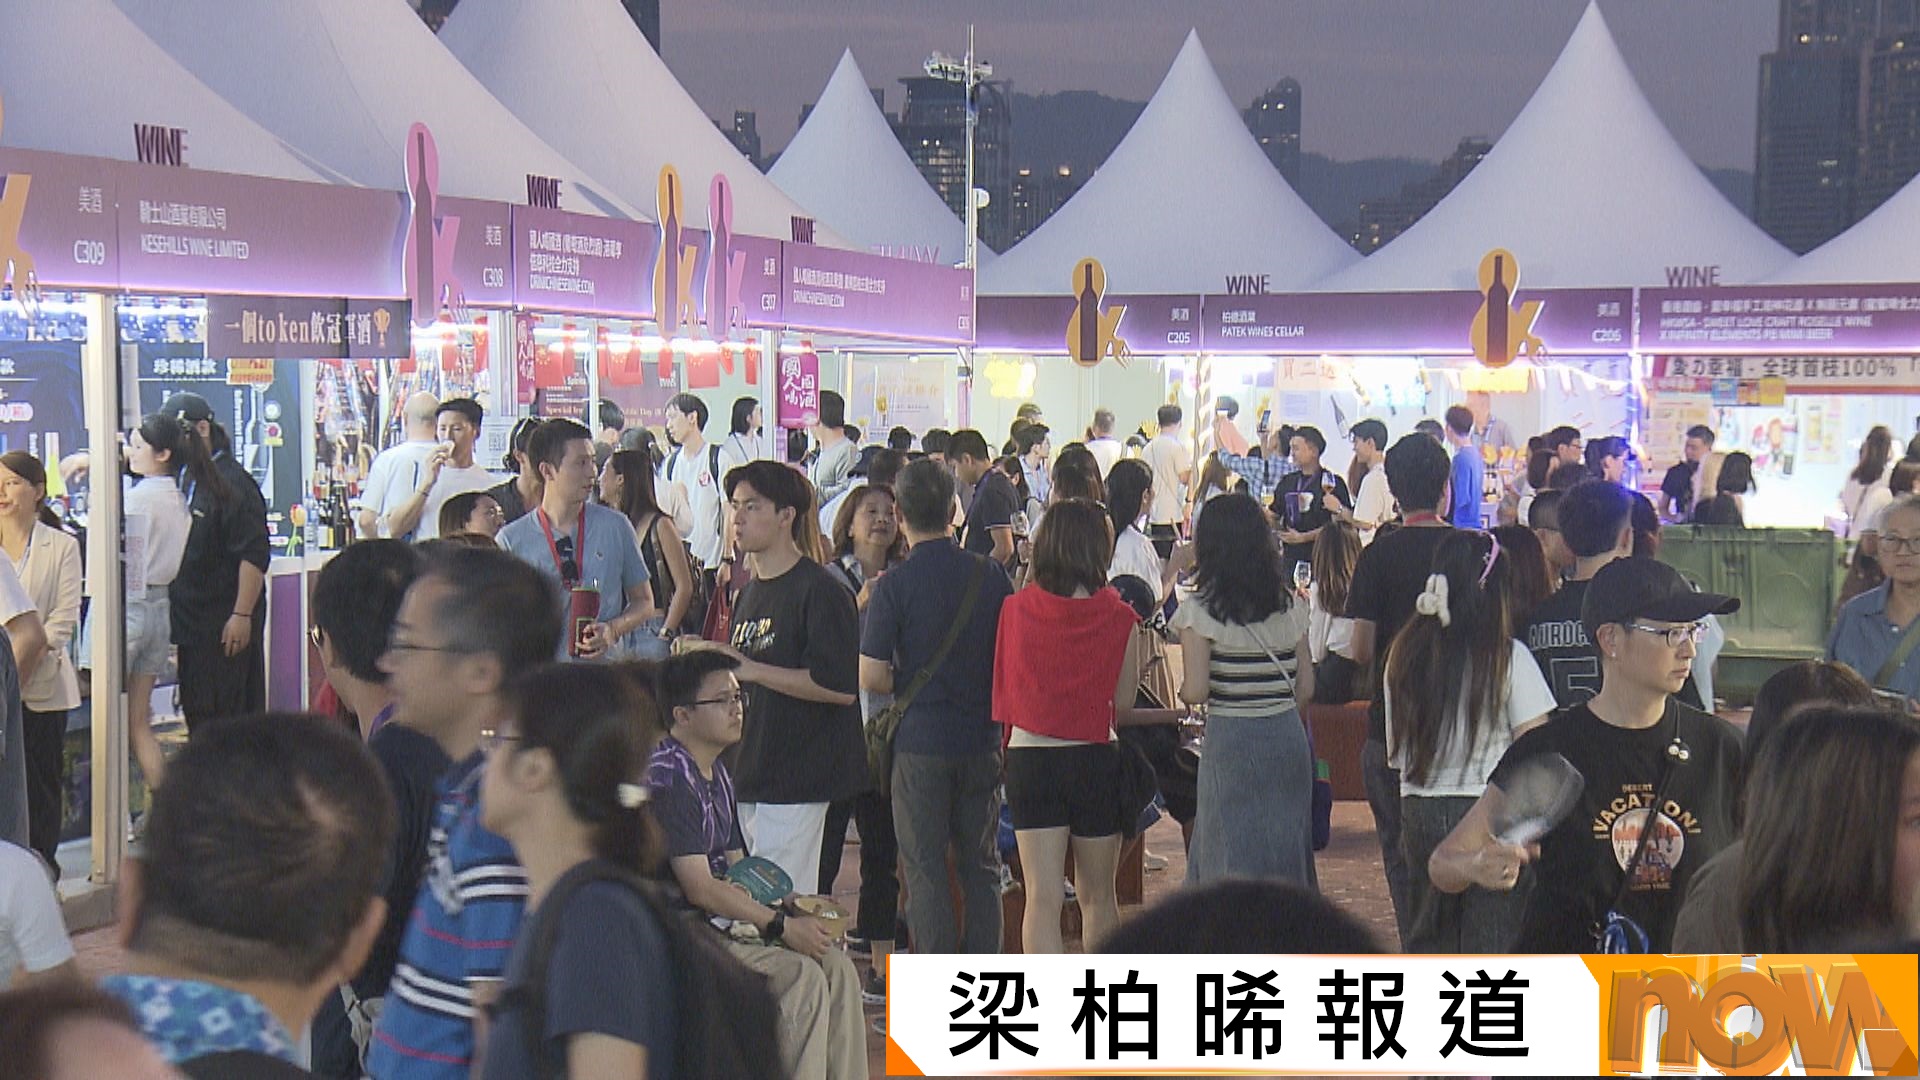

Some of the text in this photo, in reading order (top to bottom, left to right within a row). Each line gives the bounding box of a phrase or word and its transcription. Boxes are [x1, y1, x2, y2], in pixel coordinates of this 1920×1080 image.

[134, 122, 190, 168] WINE
[78, 186, 103, 214] 美酒
[526, 174, 563, 209] WINE
[791, 215, 816, 245] WINE
[74, 239, 106, 266] C309
[140, 233, 249, 260] KESEHILLS WINE LIMITED
[483, 267, 504, 289] C308
[1225, 274, 1271, 295] WINE
[1665, 266, 1720, 288] WINE
[761, 293, 777, 311] C307
[1167, 332, 1191, 344] C205
[1221, 324, 1305, 338] PATEK WINES CELLAR
[1593, 793, 1698, 833] VACATON
